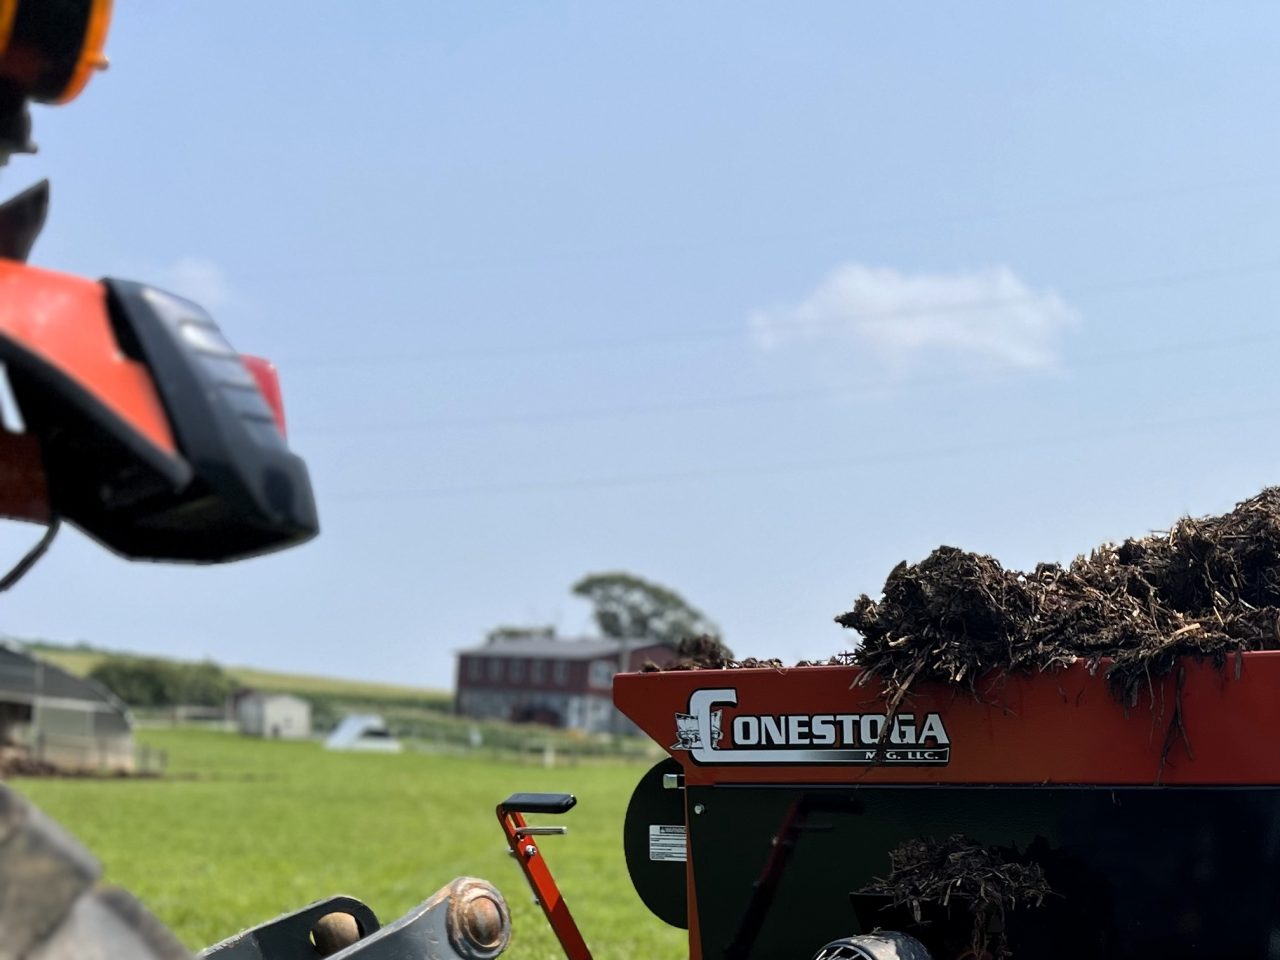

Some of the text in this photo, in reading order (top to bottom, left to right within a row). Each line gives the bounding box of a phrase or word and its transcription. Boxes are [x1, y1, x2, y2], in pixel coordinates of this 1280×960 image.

[690, 688, 950, 763] CONESTOGA
[865, 751, 939, 759] MG. LLC.
